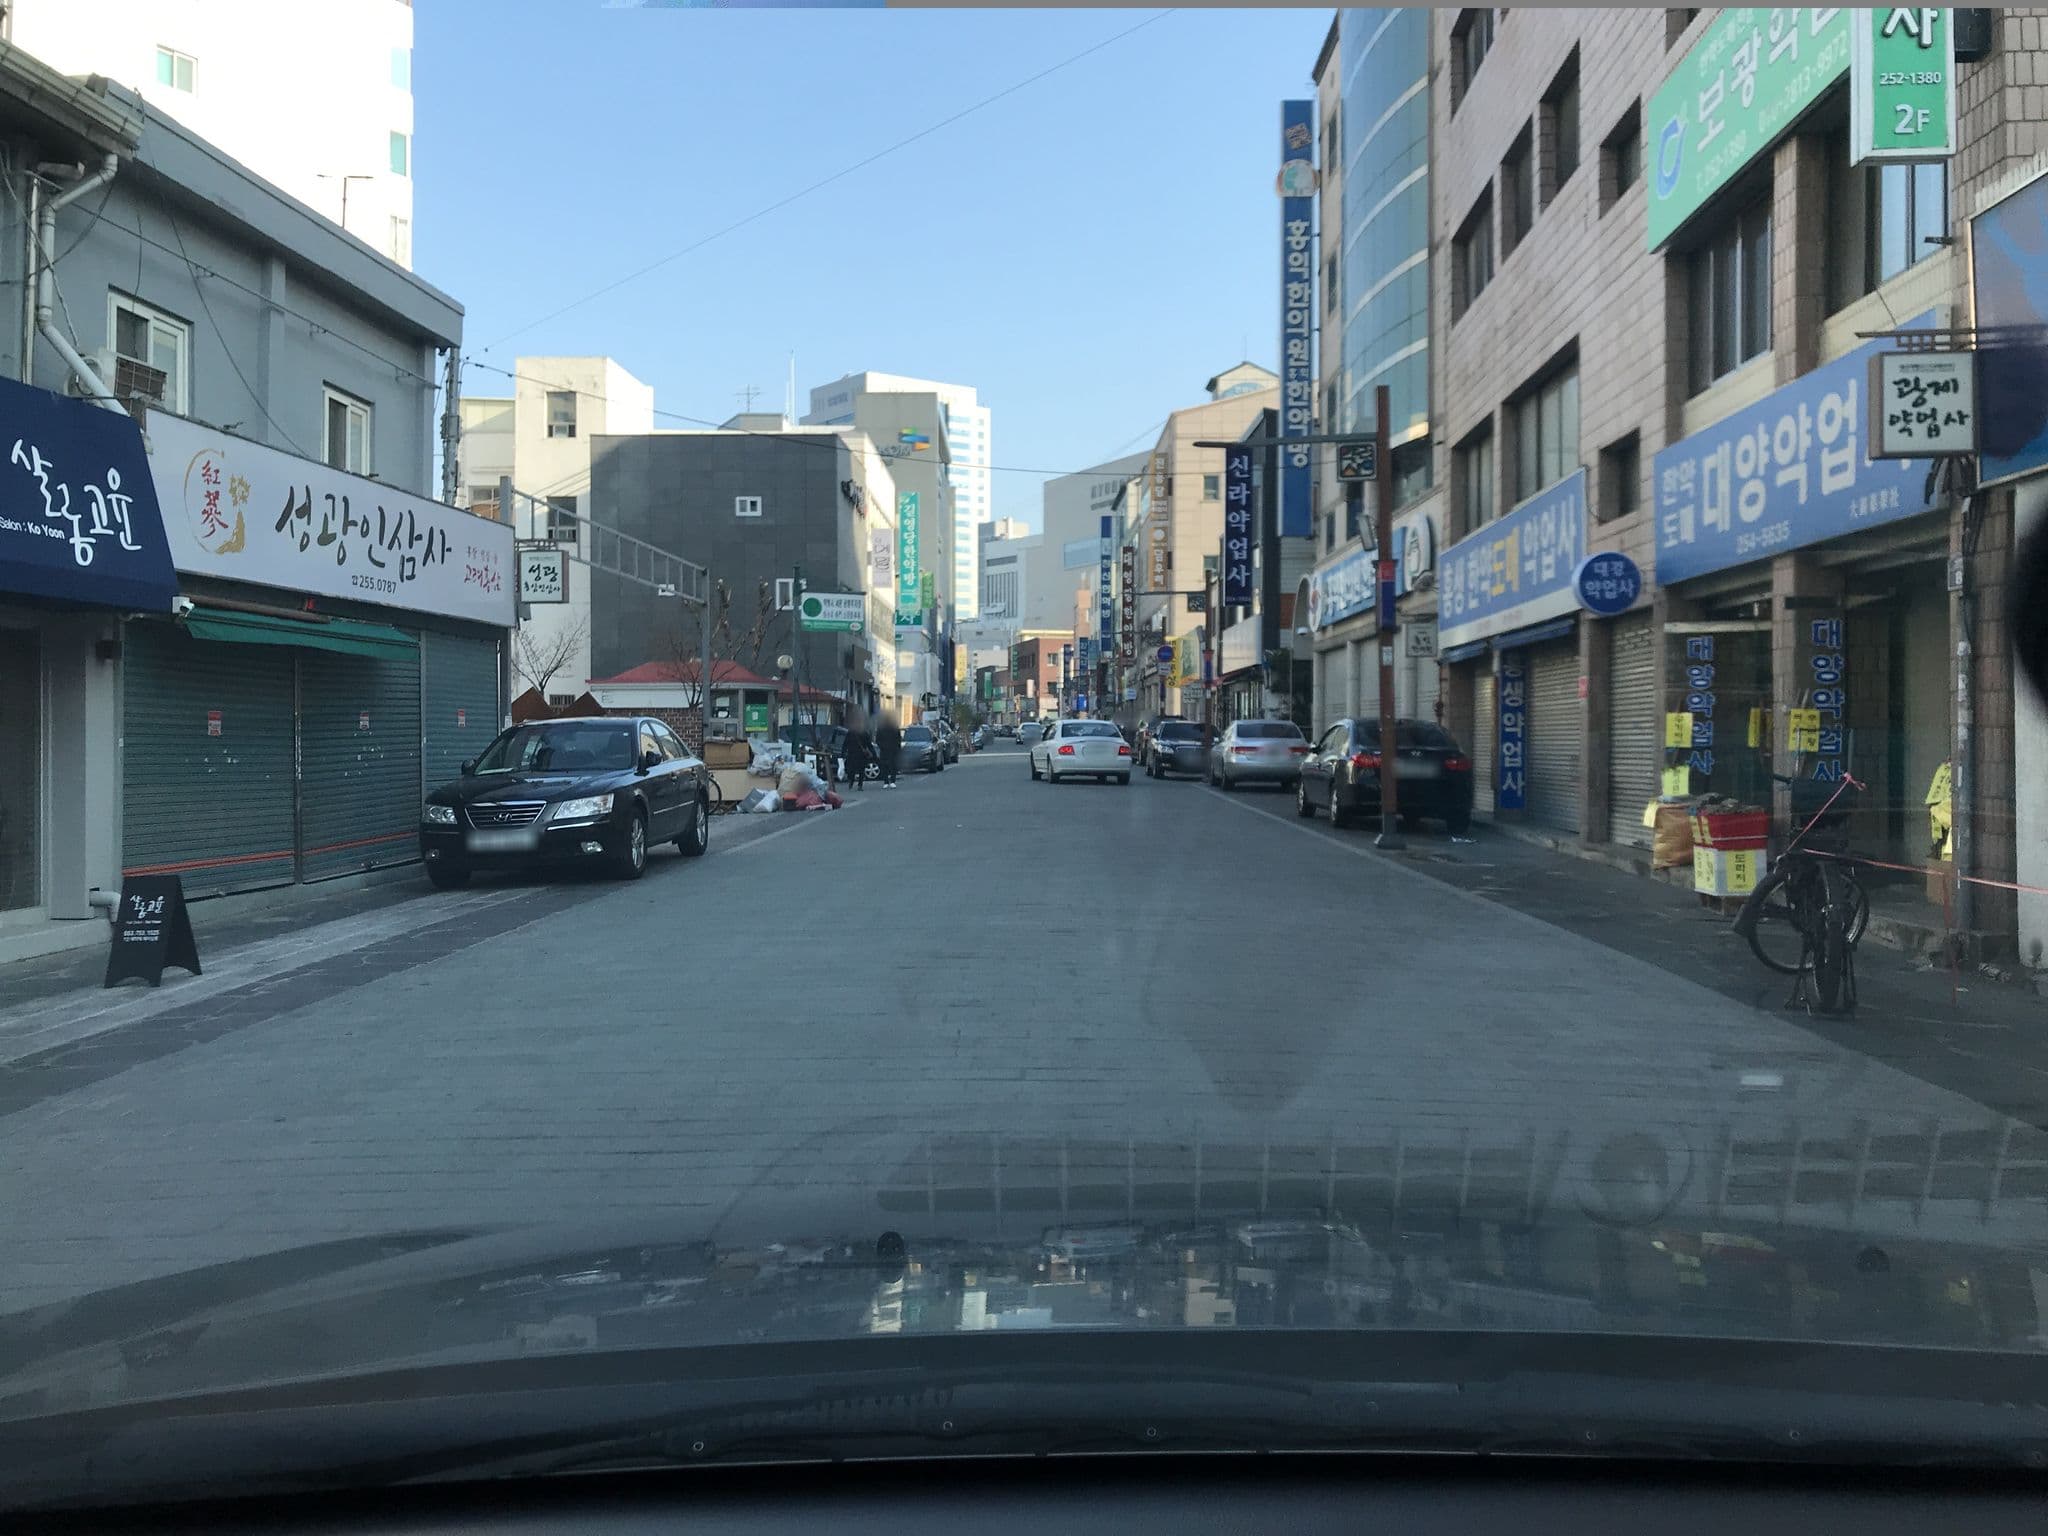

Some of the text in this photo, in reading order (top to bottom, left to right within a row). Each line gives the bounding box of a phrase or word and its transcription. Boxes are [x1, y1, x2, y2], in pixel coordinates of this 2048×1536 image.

[1697, 8, 1842, 152] 보광약
[1879, 72, 1942, 85] 252-1380
[1895, 104, 1930, 134] 2F
[1892, 376, 1960, 408] 광제
[1888, 407, 1969, 438] 약업사
[1703, 378, 1912, 533] 대양약업
[27, 521, 41, 535] Ko
[41, 523, 65, 540] Yoon
[275, 484, 451, 583] 성광인삼사
[1228, 455, 1251, 588] 신라약업사
[1663, 504, 1695, 548] 도매
[1491, 527, 1520, 597] 도매
[1523, 493, 1577, 586] 약업사
[358, 577, 397, 595] 255.0787
[528, 563, 559, 581] 성광
